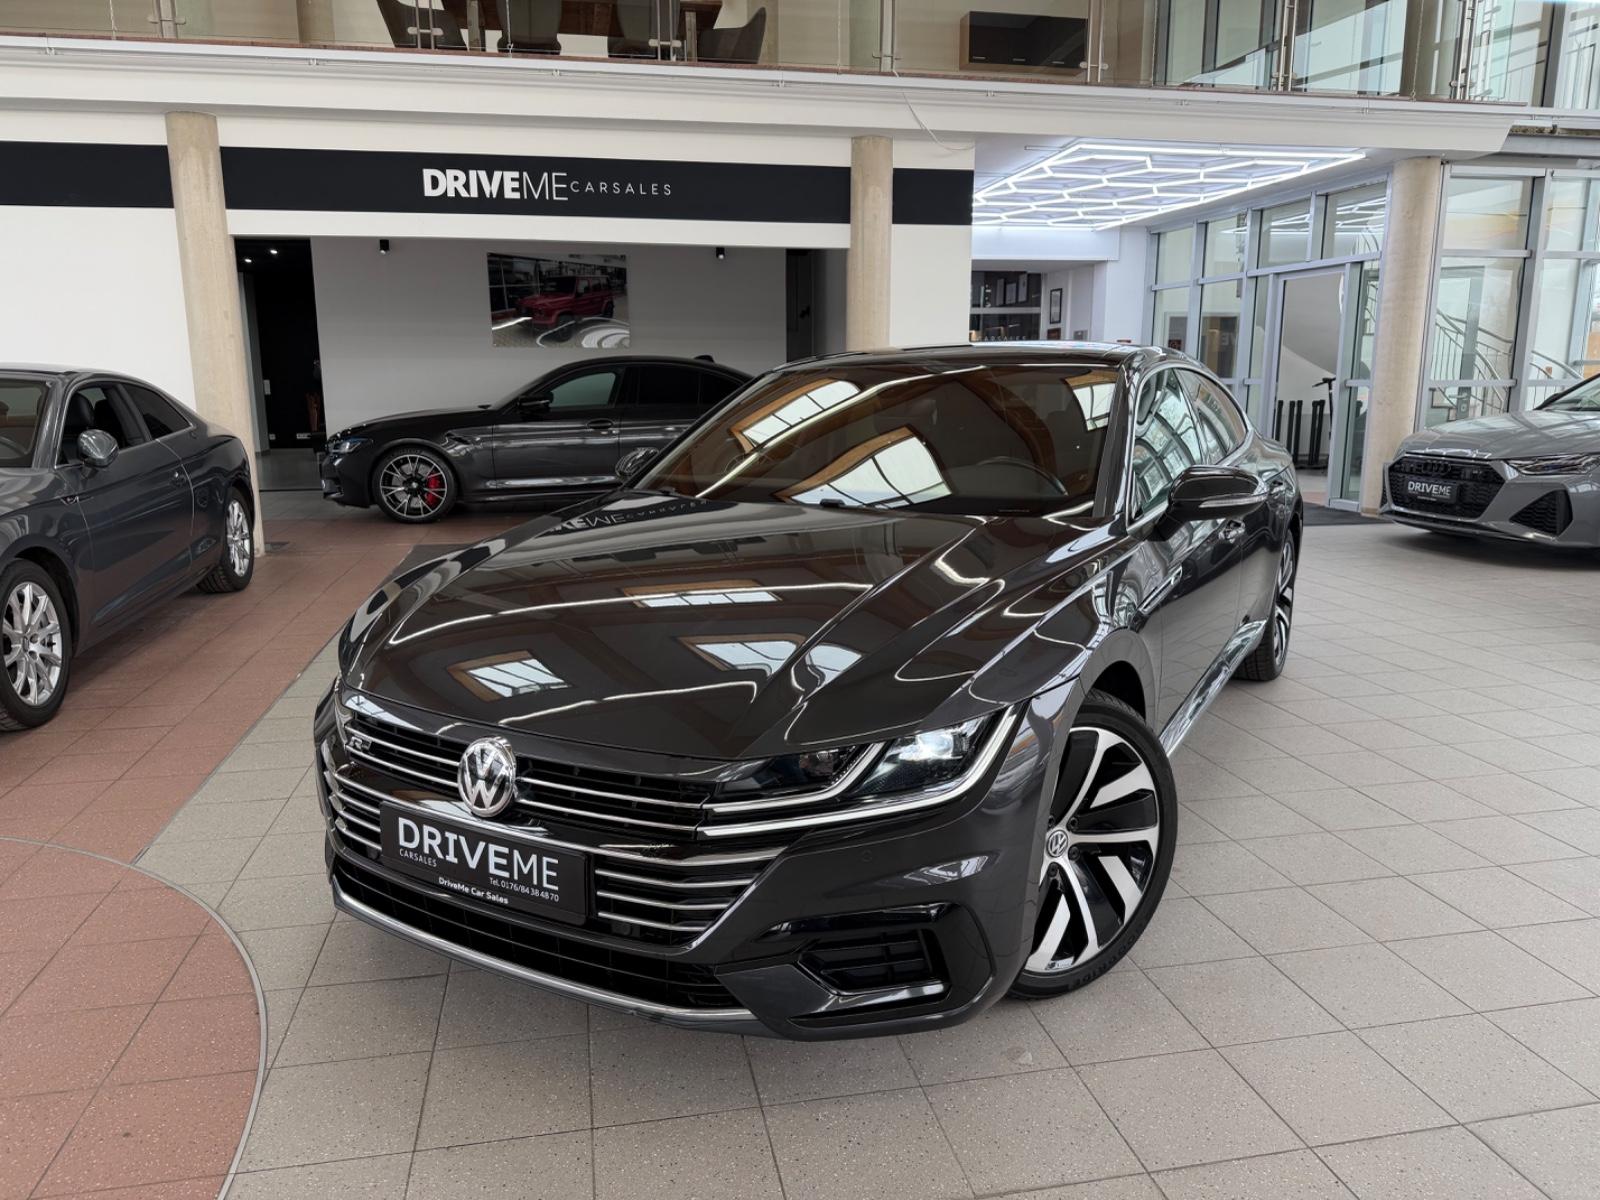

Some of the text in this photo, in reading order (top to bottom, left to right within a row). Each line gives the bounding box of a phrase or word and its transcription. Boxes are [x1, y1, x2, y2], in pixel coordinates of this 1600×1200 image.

[422, 168, 672, 201] DRIVEME CARSALES
[1407, 480, 1452, 496] DRIVEME
[398, 816, 559, 891] DRIVEME
[399, 848, 437, 867] CARSALES
[438, 876, 509, 904] DriveMe Car Sales
